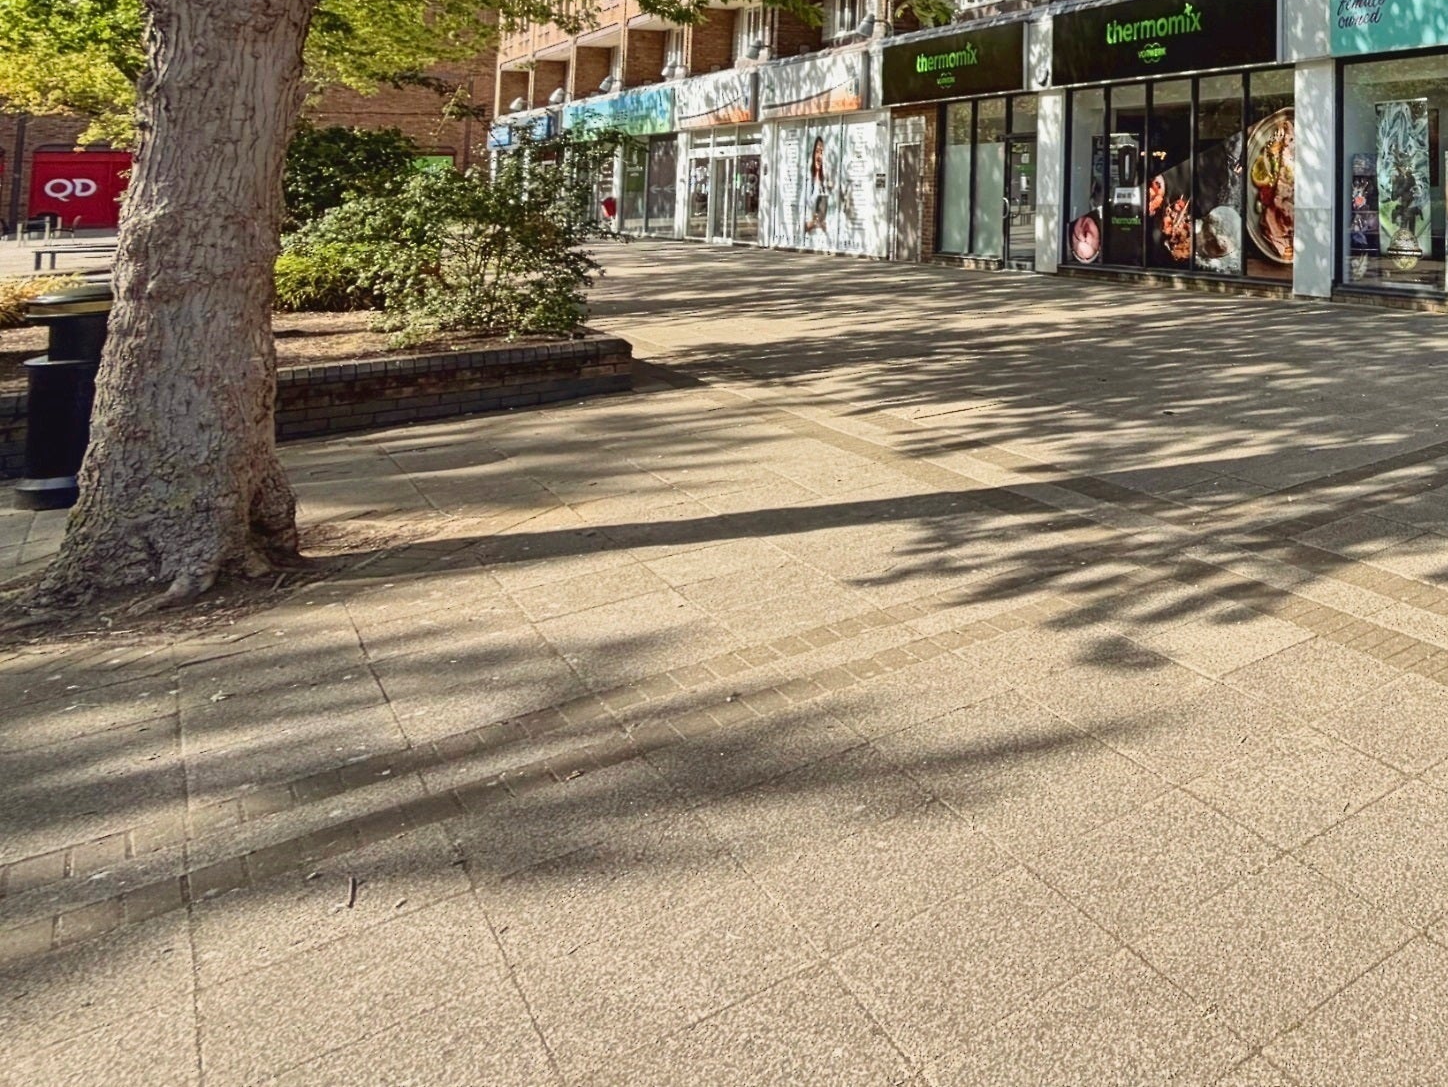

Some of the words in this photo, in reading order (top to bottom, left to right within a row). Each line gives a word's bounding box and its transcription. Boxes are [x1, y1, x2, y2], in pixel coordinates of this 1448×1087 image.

[1106, 3, 1202, 45] thermomix
[1338, 7, 1383, 29] owned
[916, 42, 978, 73] thermomix
[44, 178, 97, 202] QD
